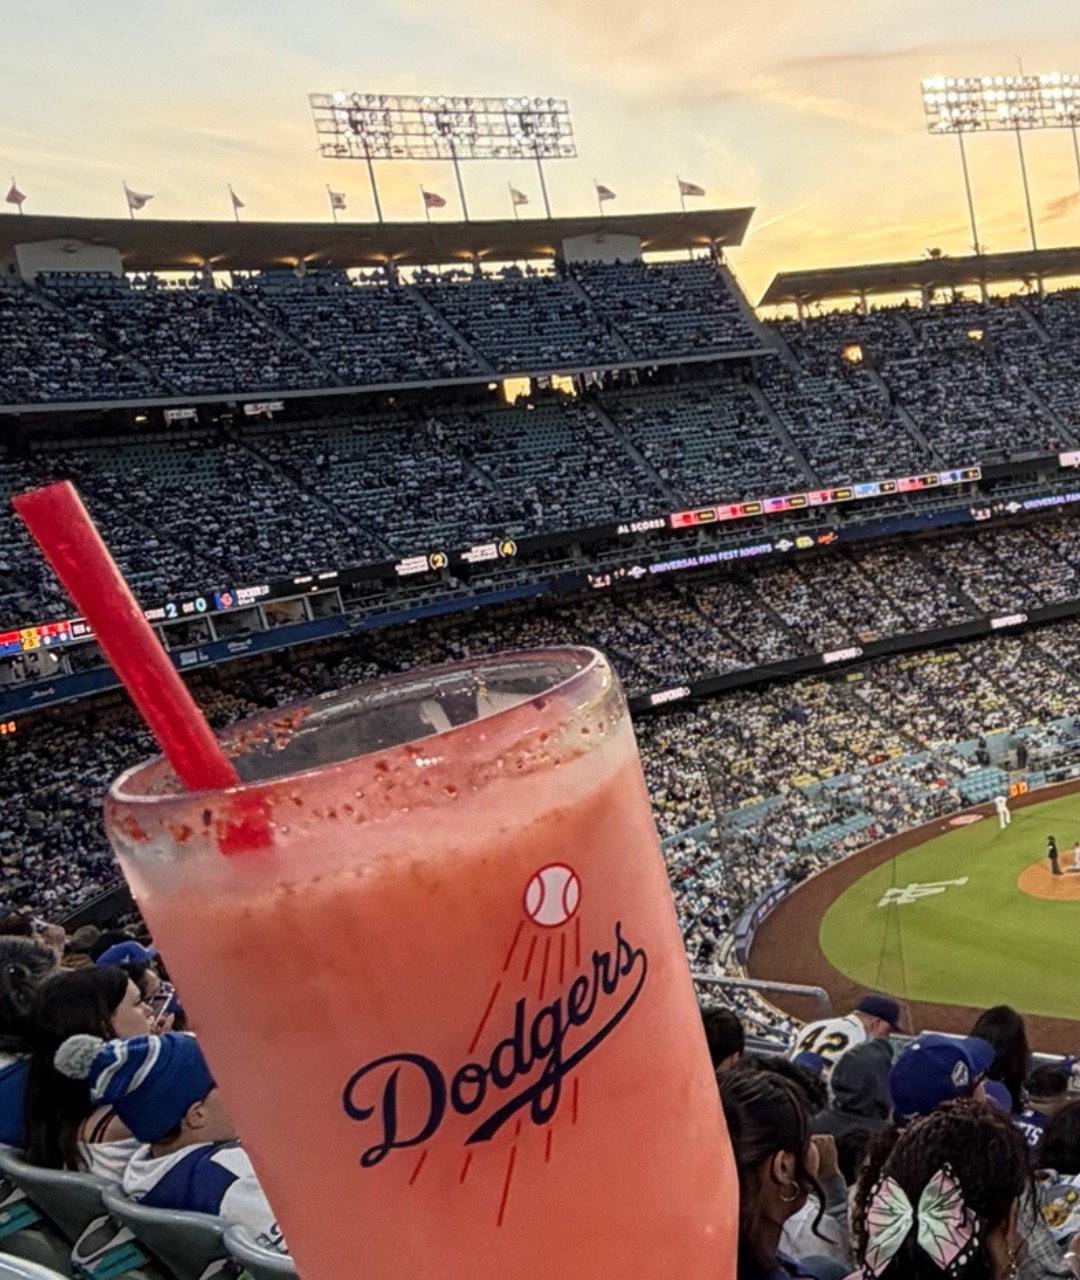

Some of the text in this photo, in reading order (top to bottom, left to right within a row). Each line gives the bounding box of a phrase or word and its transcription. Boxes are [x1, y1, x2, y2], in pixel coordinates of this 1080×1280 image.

[1023, 493, 1066, 510] UNIVERSAL
[631, 517, 666, 533] SCORES
[649, 542, 773, 574] UNIVERSAL FAN FEST NIGHTS
[165, 602, 178, 618] 2
[342, 920, 648, 1168] Dodgers
[798, 1025, 850, 1067] 42
